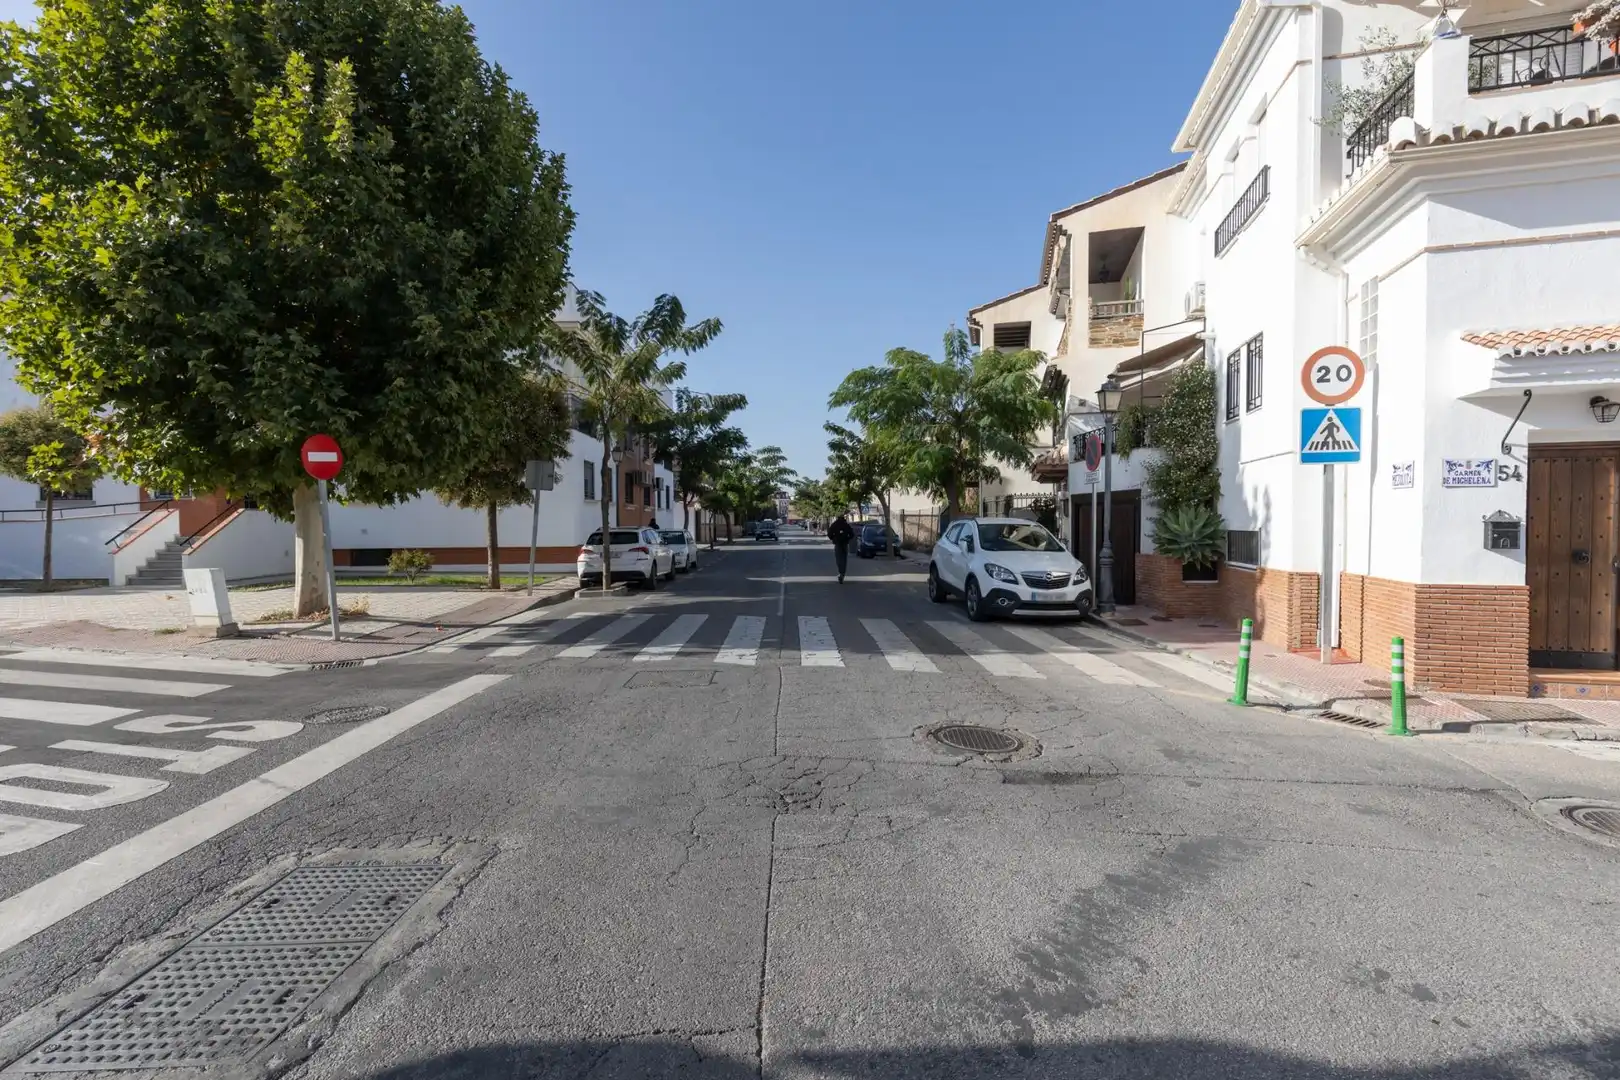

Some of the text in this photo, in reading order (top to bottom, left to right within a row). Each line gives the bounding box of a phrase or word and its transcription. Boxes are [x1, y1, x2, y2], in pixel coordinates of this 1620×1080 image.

[1316, 364, 1352, 383] 20
[1454, 469, 1482, 477] CARMEN
[1498, 464, 1522, 481] 54
[1442, 476, 1492, 485] DE MICHELENA
